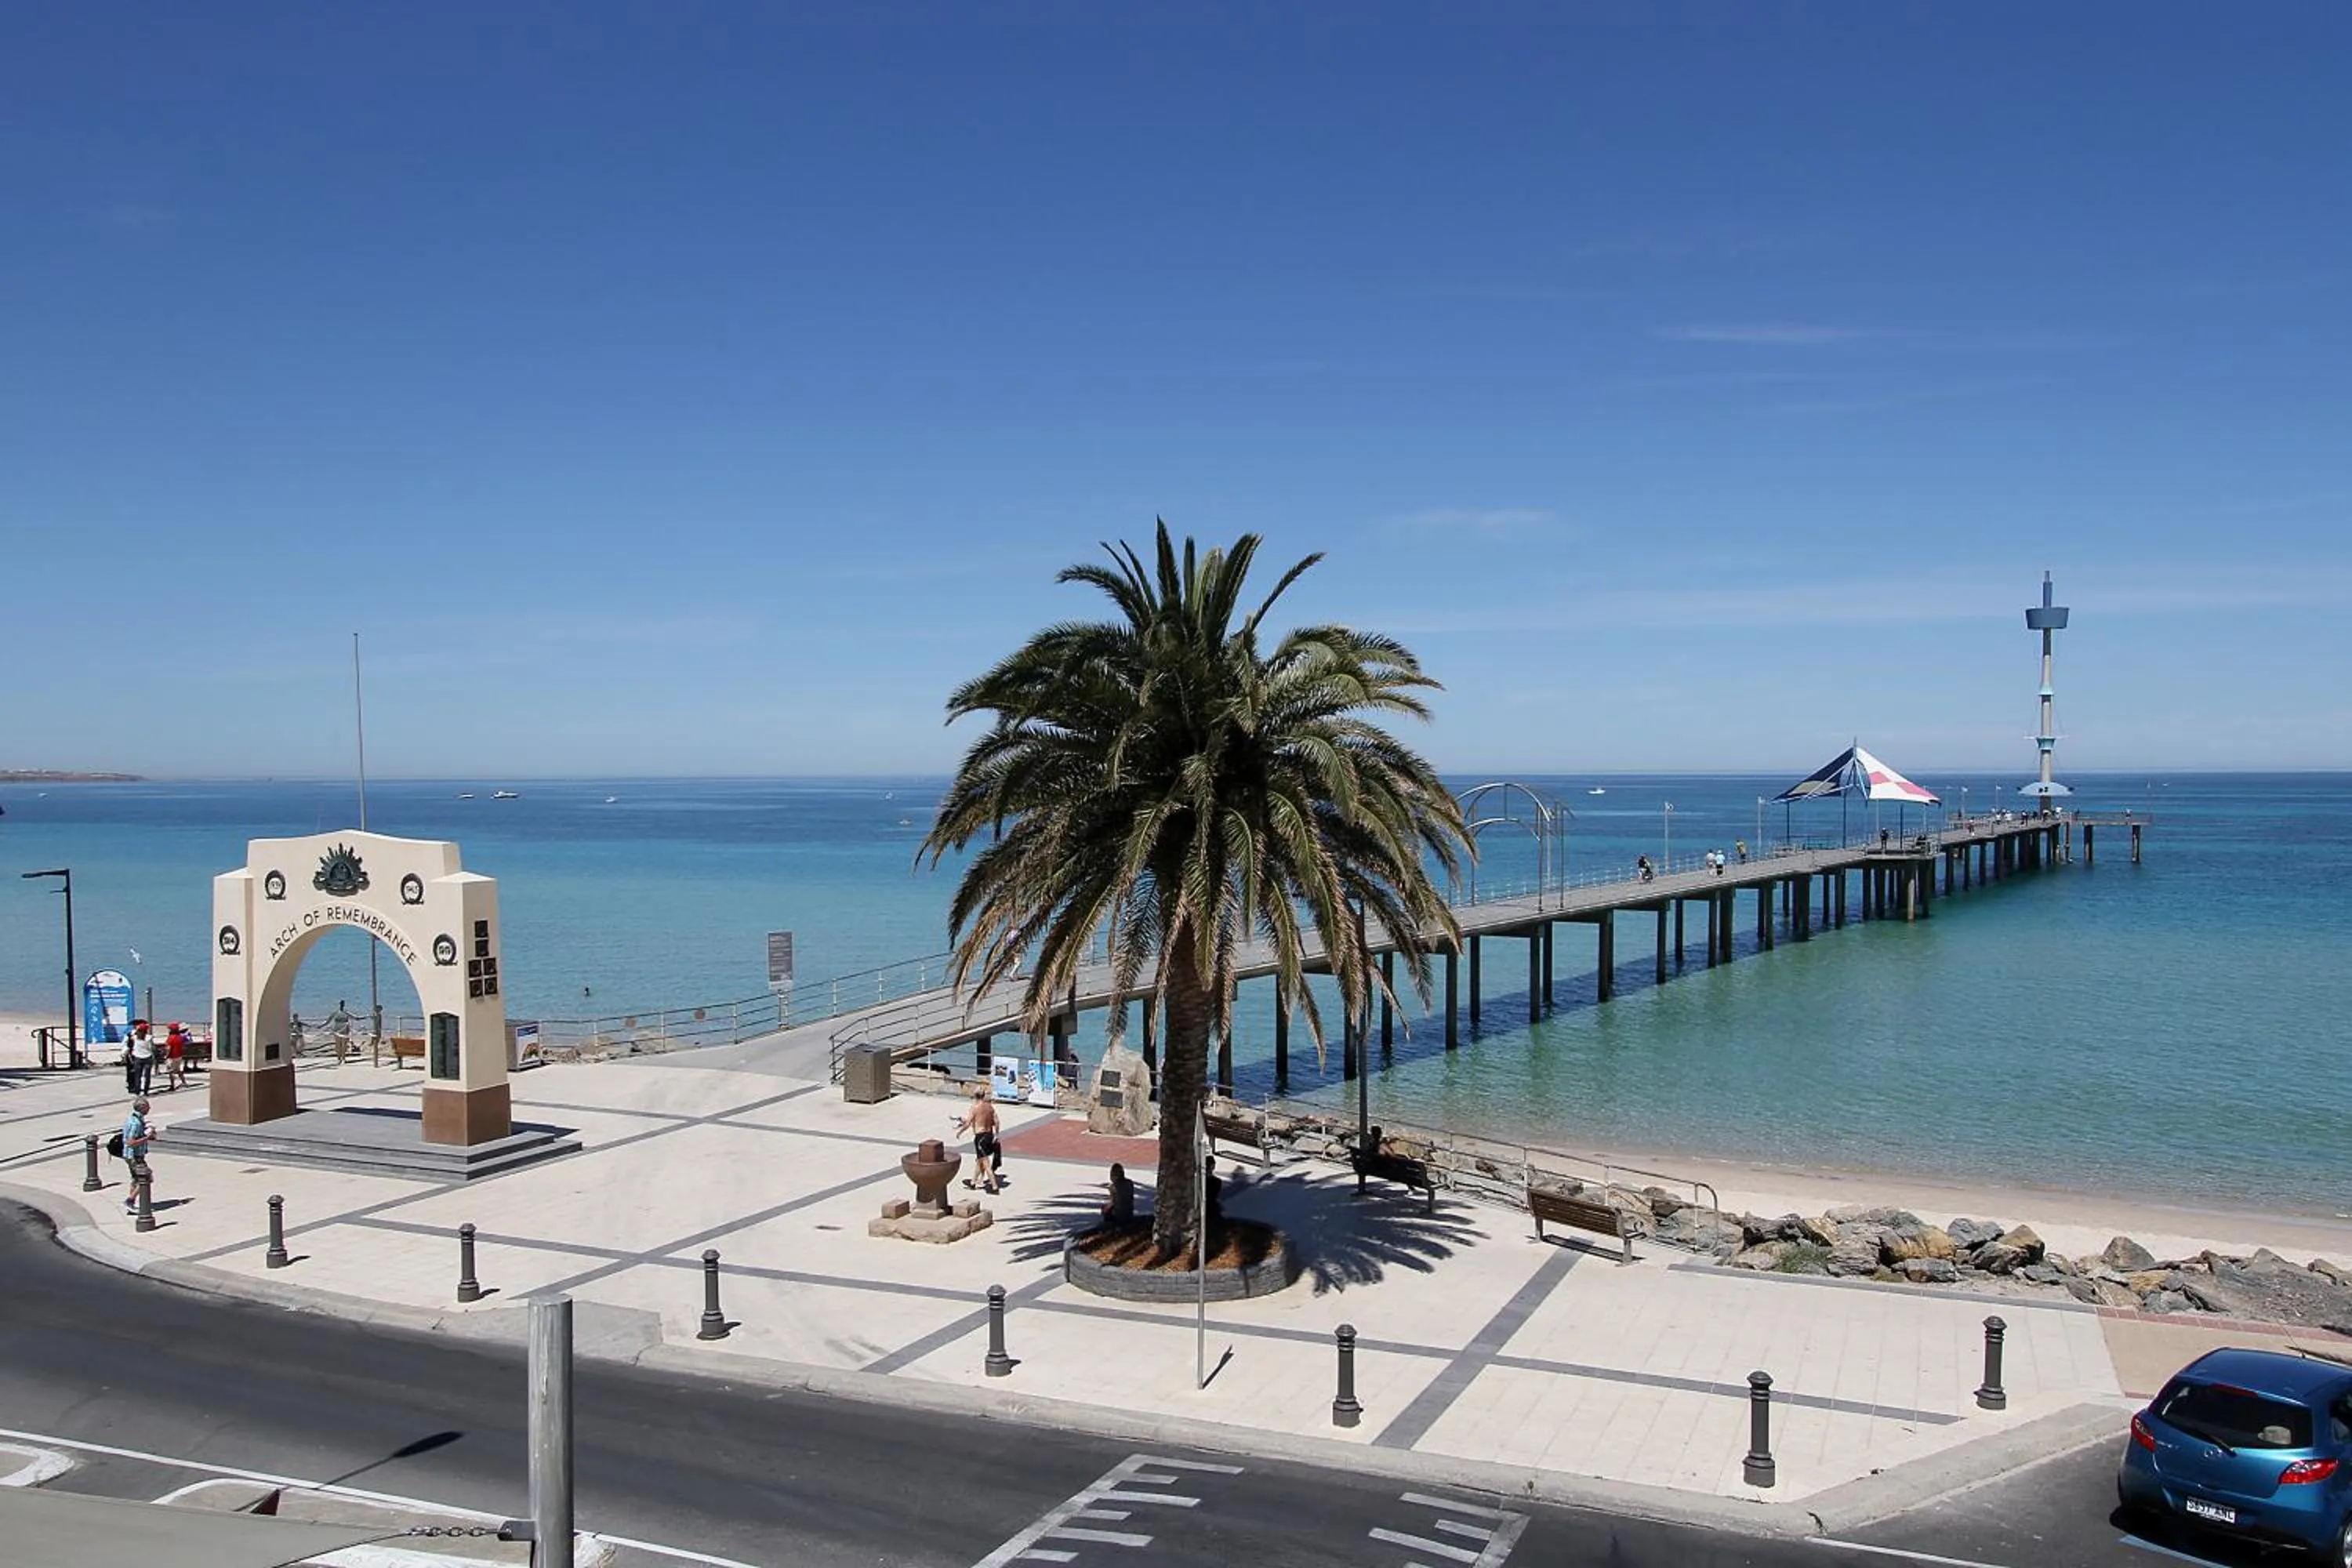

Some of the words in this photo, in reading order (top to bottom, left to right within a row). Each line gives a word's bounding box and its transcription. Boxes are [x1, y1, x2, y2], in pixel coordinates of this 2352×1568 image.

[270, 923, 299, 958] ARCH
[303, 910, 320, 927] OF
[327, 906, 417, 966] REMEMBRANCE
